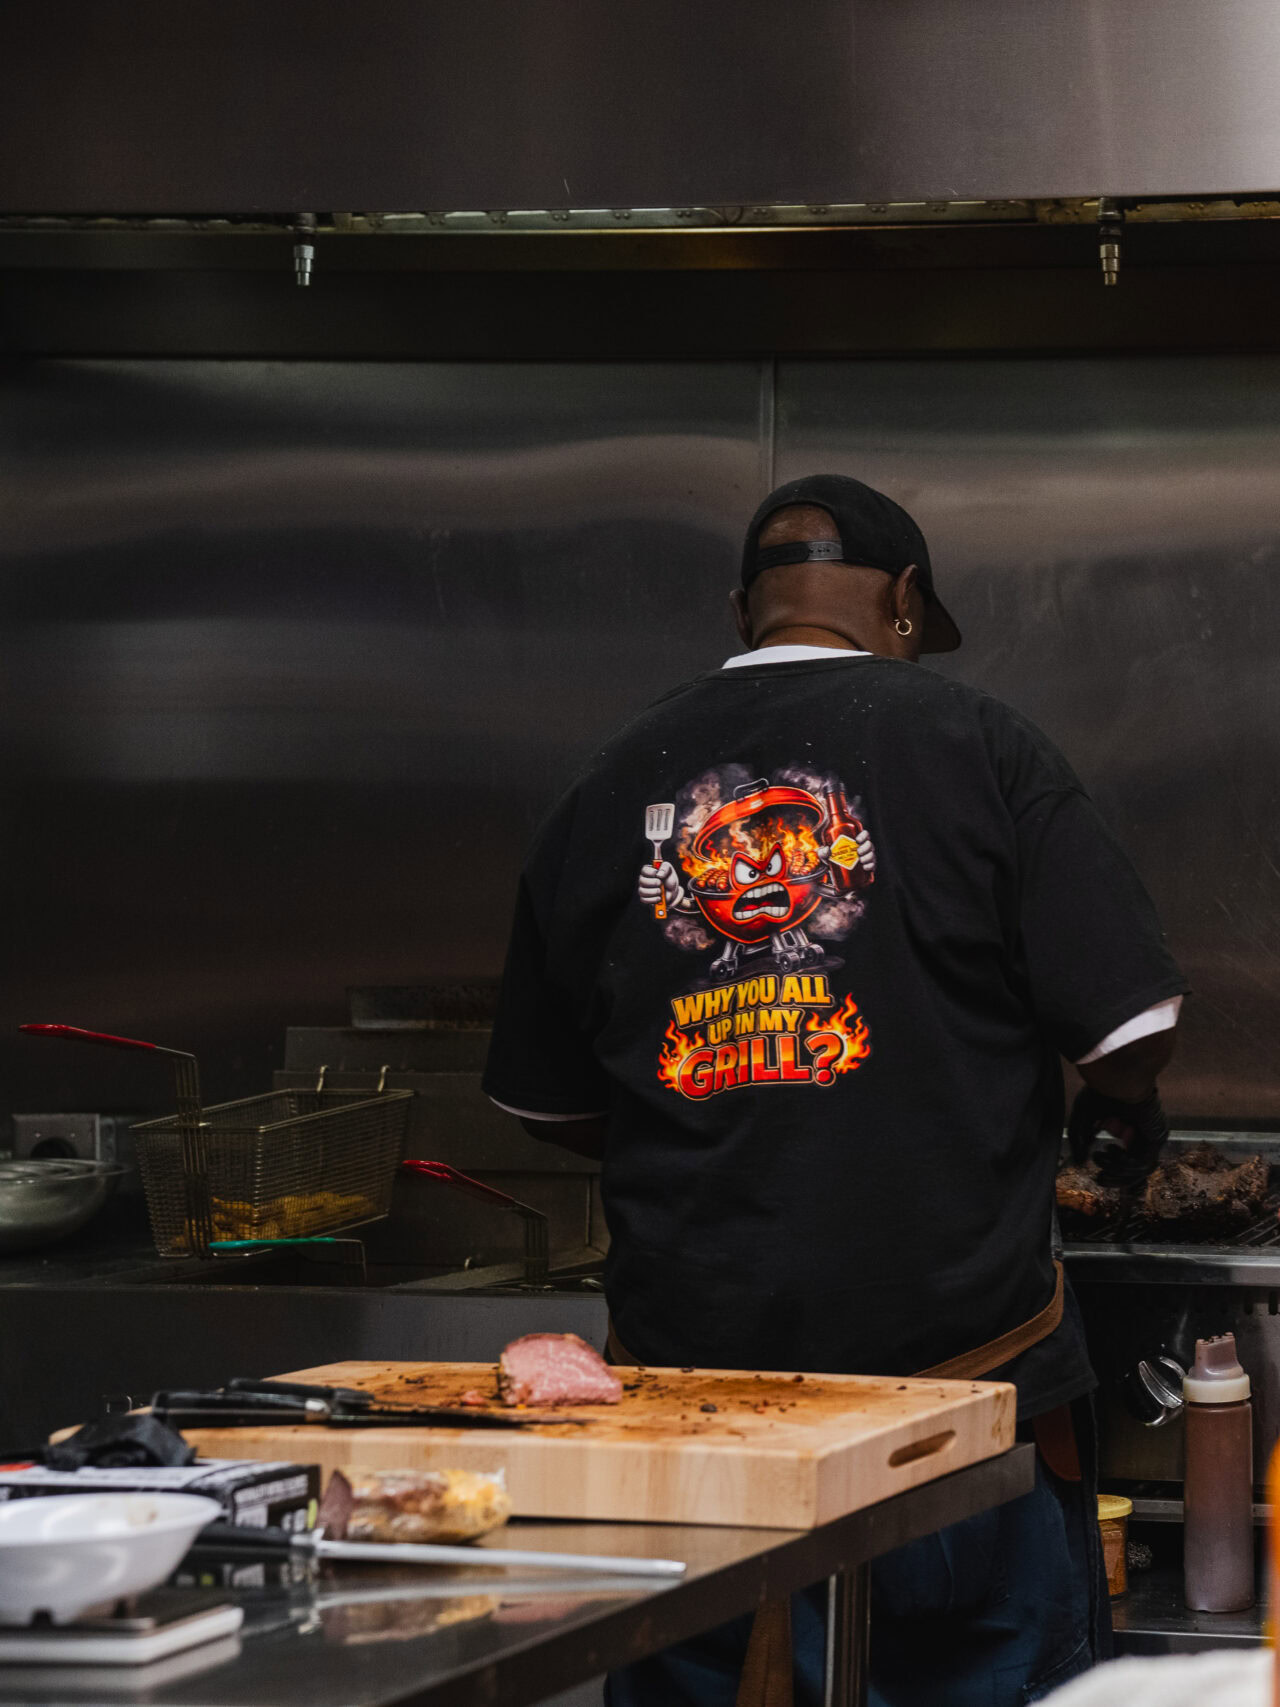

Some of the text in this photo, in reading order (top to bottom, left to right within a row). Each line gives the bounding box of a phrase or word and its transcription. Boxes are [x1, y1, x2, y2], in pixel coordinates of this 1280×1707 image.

[673, 976, 831, 1026] WHY YOU ALL
[709, 1009, 801, 1045] UP IN MY
[679, 1034, 841, 1096] GRILL?
